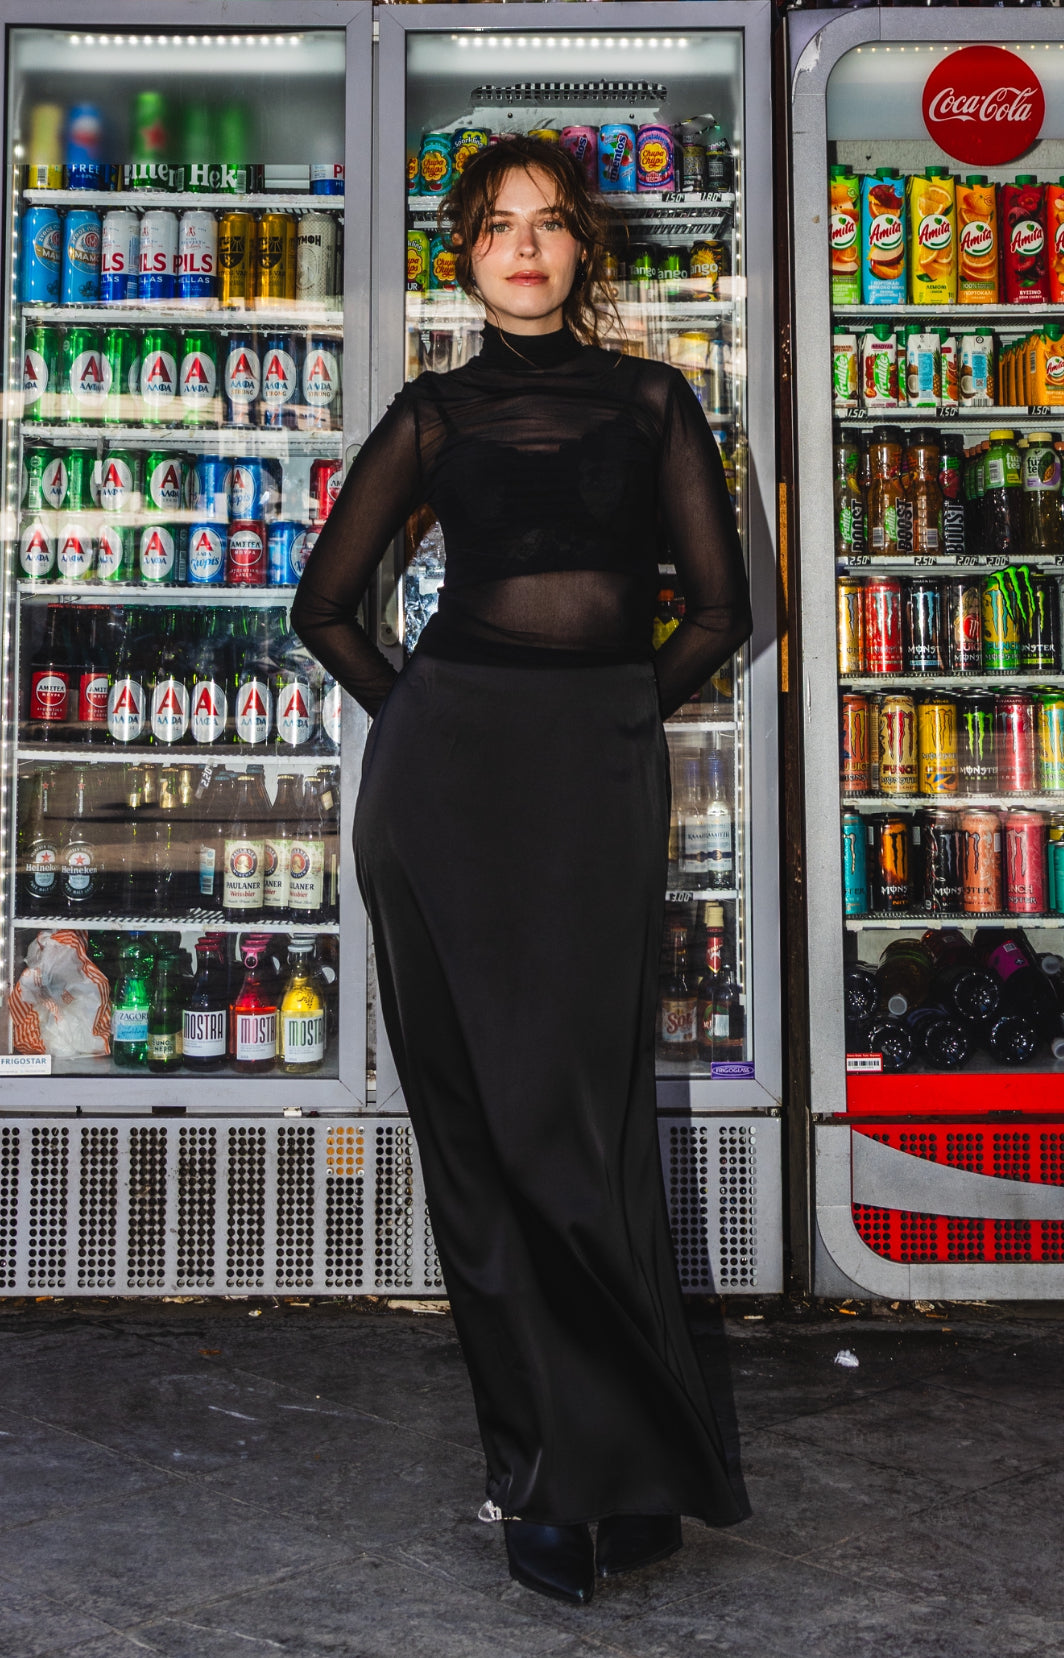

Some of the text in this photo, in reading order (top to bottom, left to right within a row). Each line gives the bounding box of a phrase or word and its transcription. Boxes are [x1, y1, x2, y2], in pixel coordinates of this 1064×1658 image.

[928, 87, 1038, 122] Coca-Cola
[611, 135, 626, 180] mentos
[642, 156, 663, 168] Chups
[870, 220, 902, 246] Amita
[918, 220, 950, 246] Amita
[961, 228, 992, 252] Amita
[1010, 227, 1042, 254] Amita
[173, 254, 213, 273] PILS
[226, 881, 260, 890] PAULANER
[184, 1013, 224, 1040] MOSTRA
